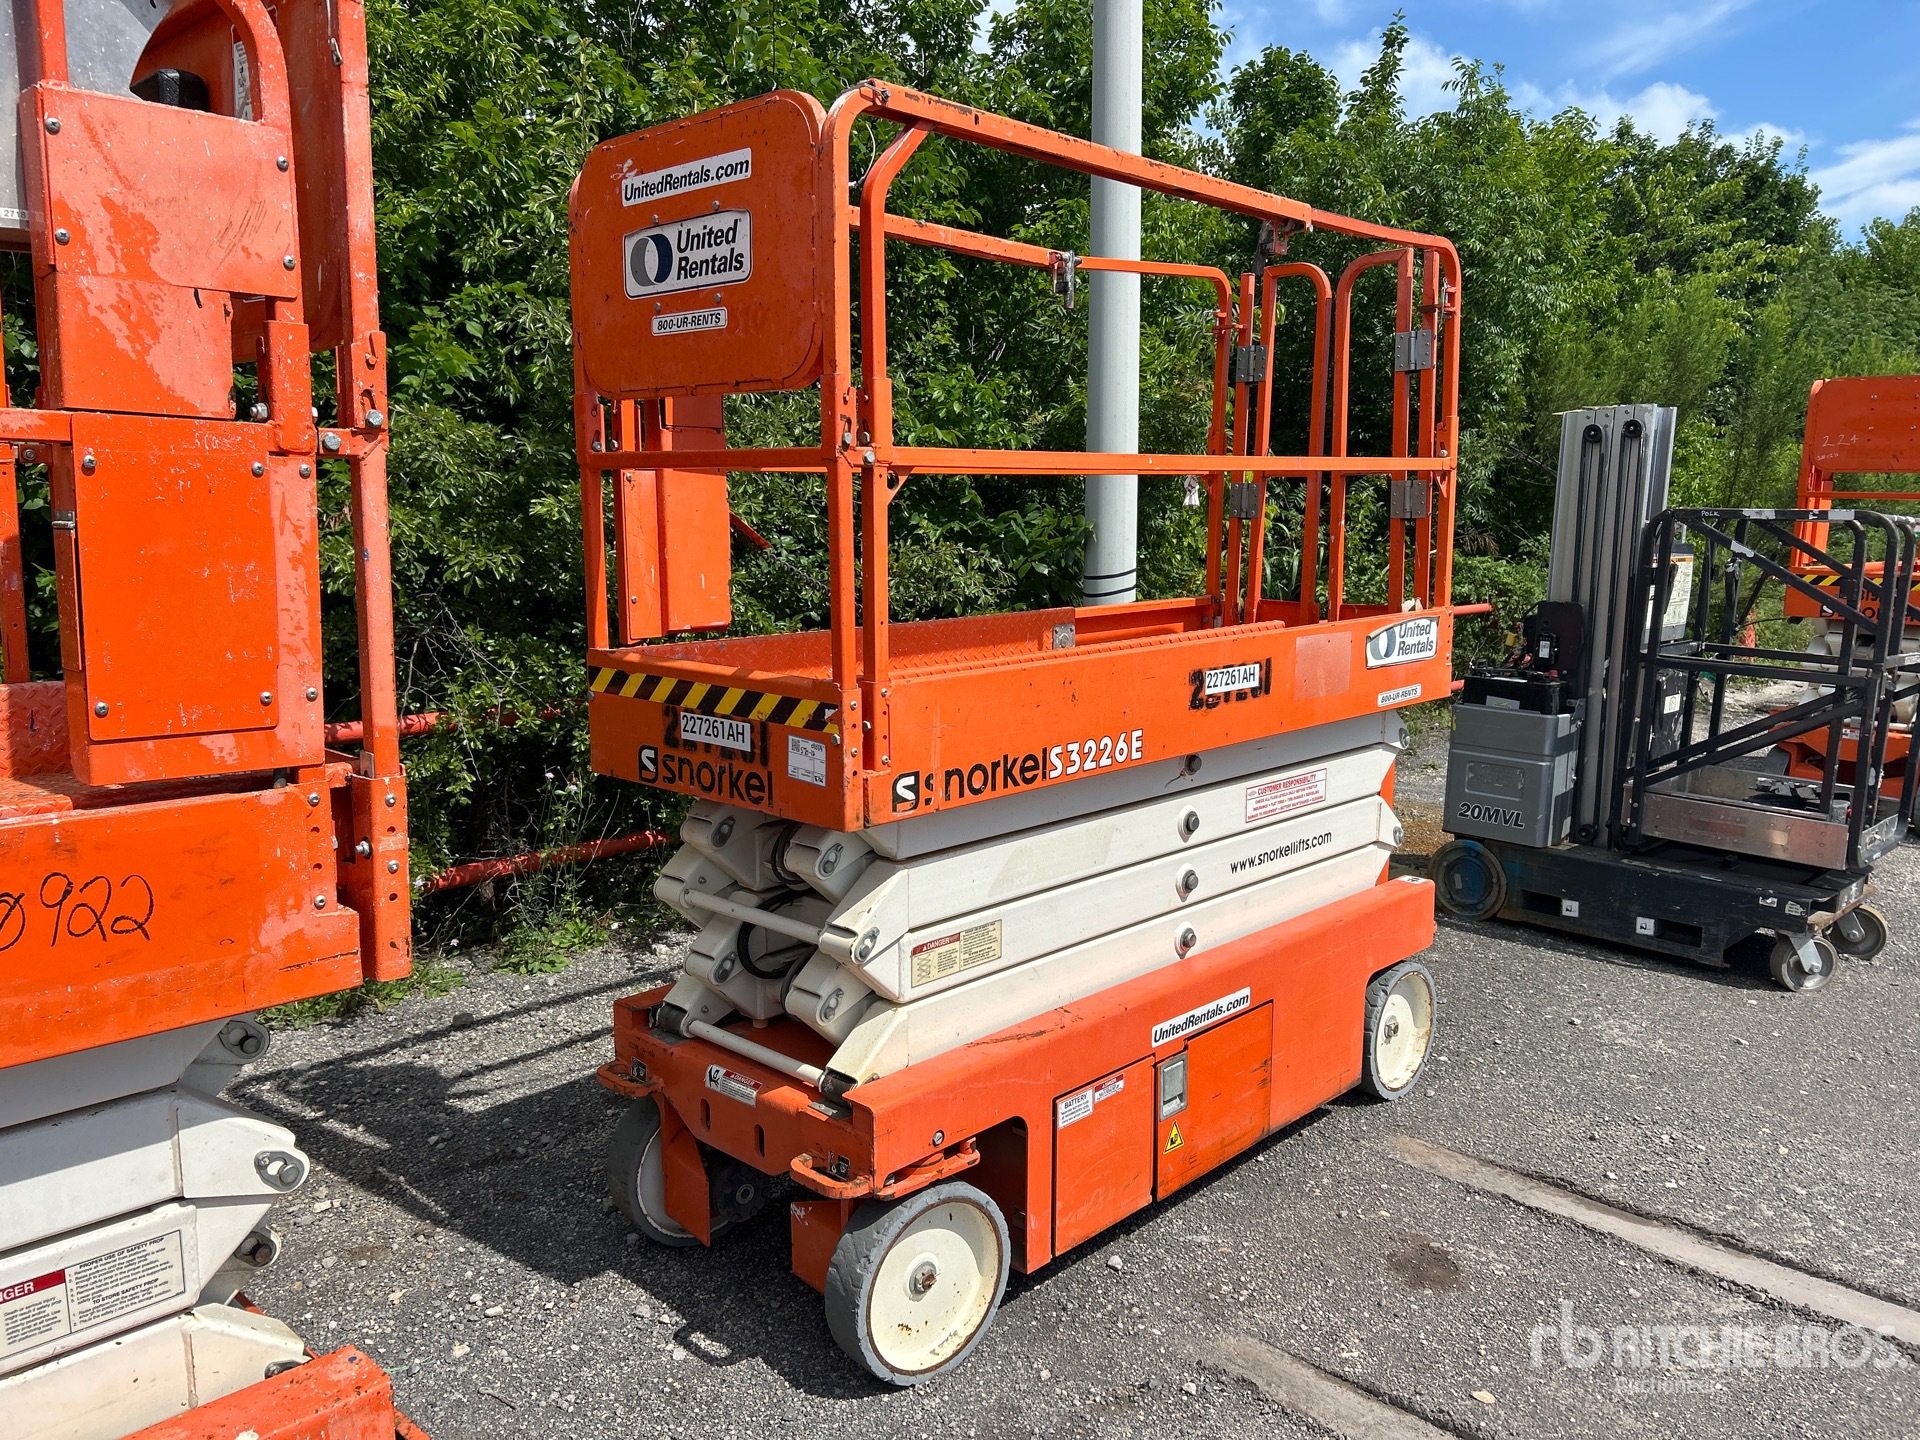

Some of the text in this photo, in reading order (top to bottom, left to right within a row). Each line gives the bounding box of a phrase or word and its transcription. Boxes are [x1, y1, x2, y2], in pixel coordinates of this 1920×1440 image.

[623, 159, 750, 202] UnitedRentals.com
[676, 218, 740, 254] United
[676, 247, 745, 281] Rentals
[656, 312, 721, 331] 800-UR-RENTS
[1399, 620, 1432, 639] United
[1397, 637, 1434, 657] Rentals
[1207, 667, 1256, 689] 227261AH
[681, 714, 746, 744] 227261AH
[924, 747, 1047, 806] snorkel
[1049, 728, 1144, 779] S3226E
[661, 753, 774, 808] snorkel
[1258, 783, 1281, 795] CUSTOMER
[1283, 774, 1316, 788] RESPONSIBILITY
[1458, 802, 1525, 829] 20MVL
[1230, 832, 1332, 874] www.snorkellifts.com
[927, 937, 950, 950] DANGER
[1153, 994, 1249, 1044] UnitedRentals.com
[734, 1075, 755, 1086] DANGER
[1064, 1093, 1088, 1110] BATTERY
[80, 1259, 103, 1269] PROPER
[127, 1244, 147, 1253] SAFETY
[0, 1282, 34, 1300] GER
[102, 1292, 120, 1301] STORE
[122, 1284, 142, 1294] SAFETY
